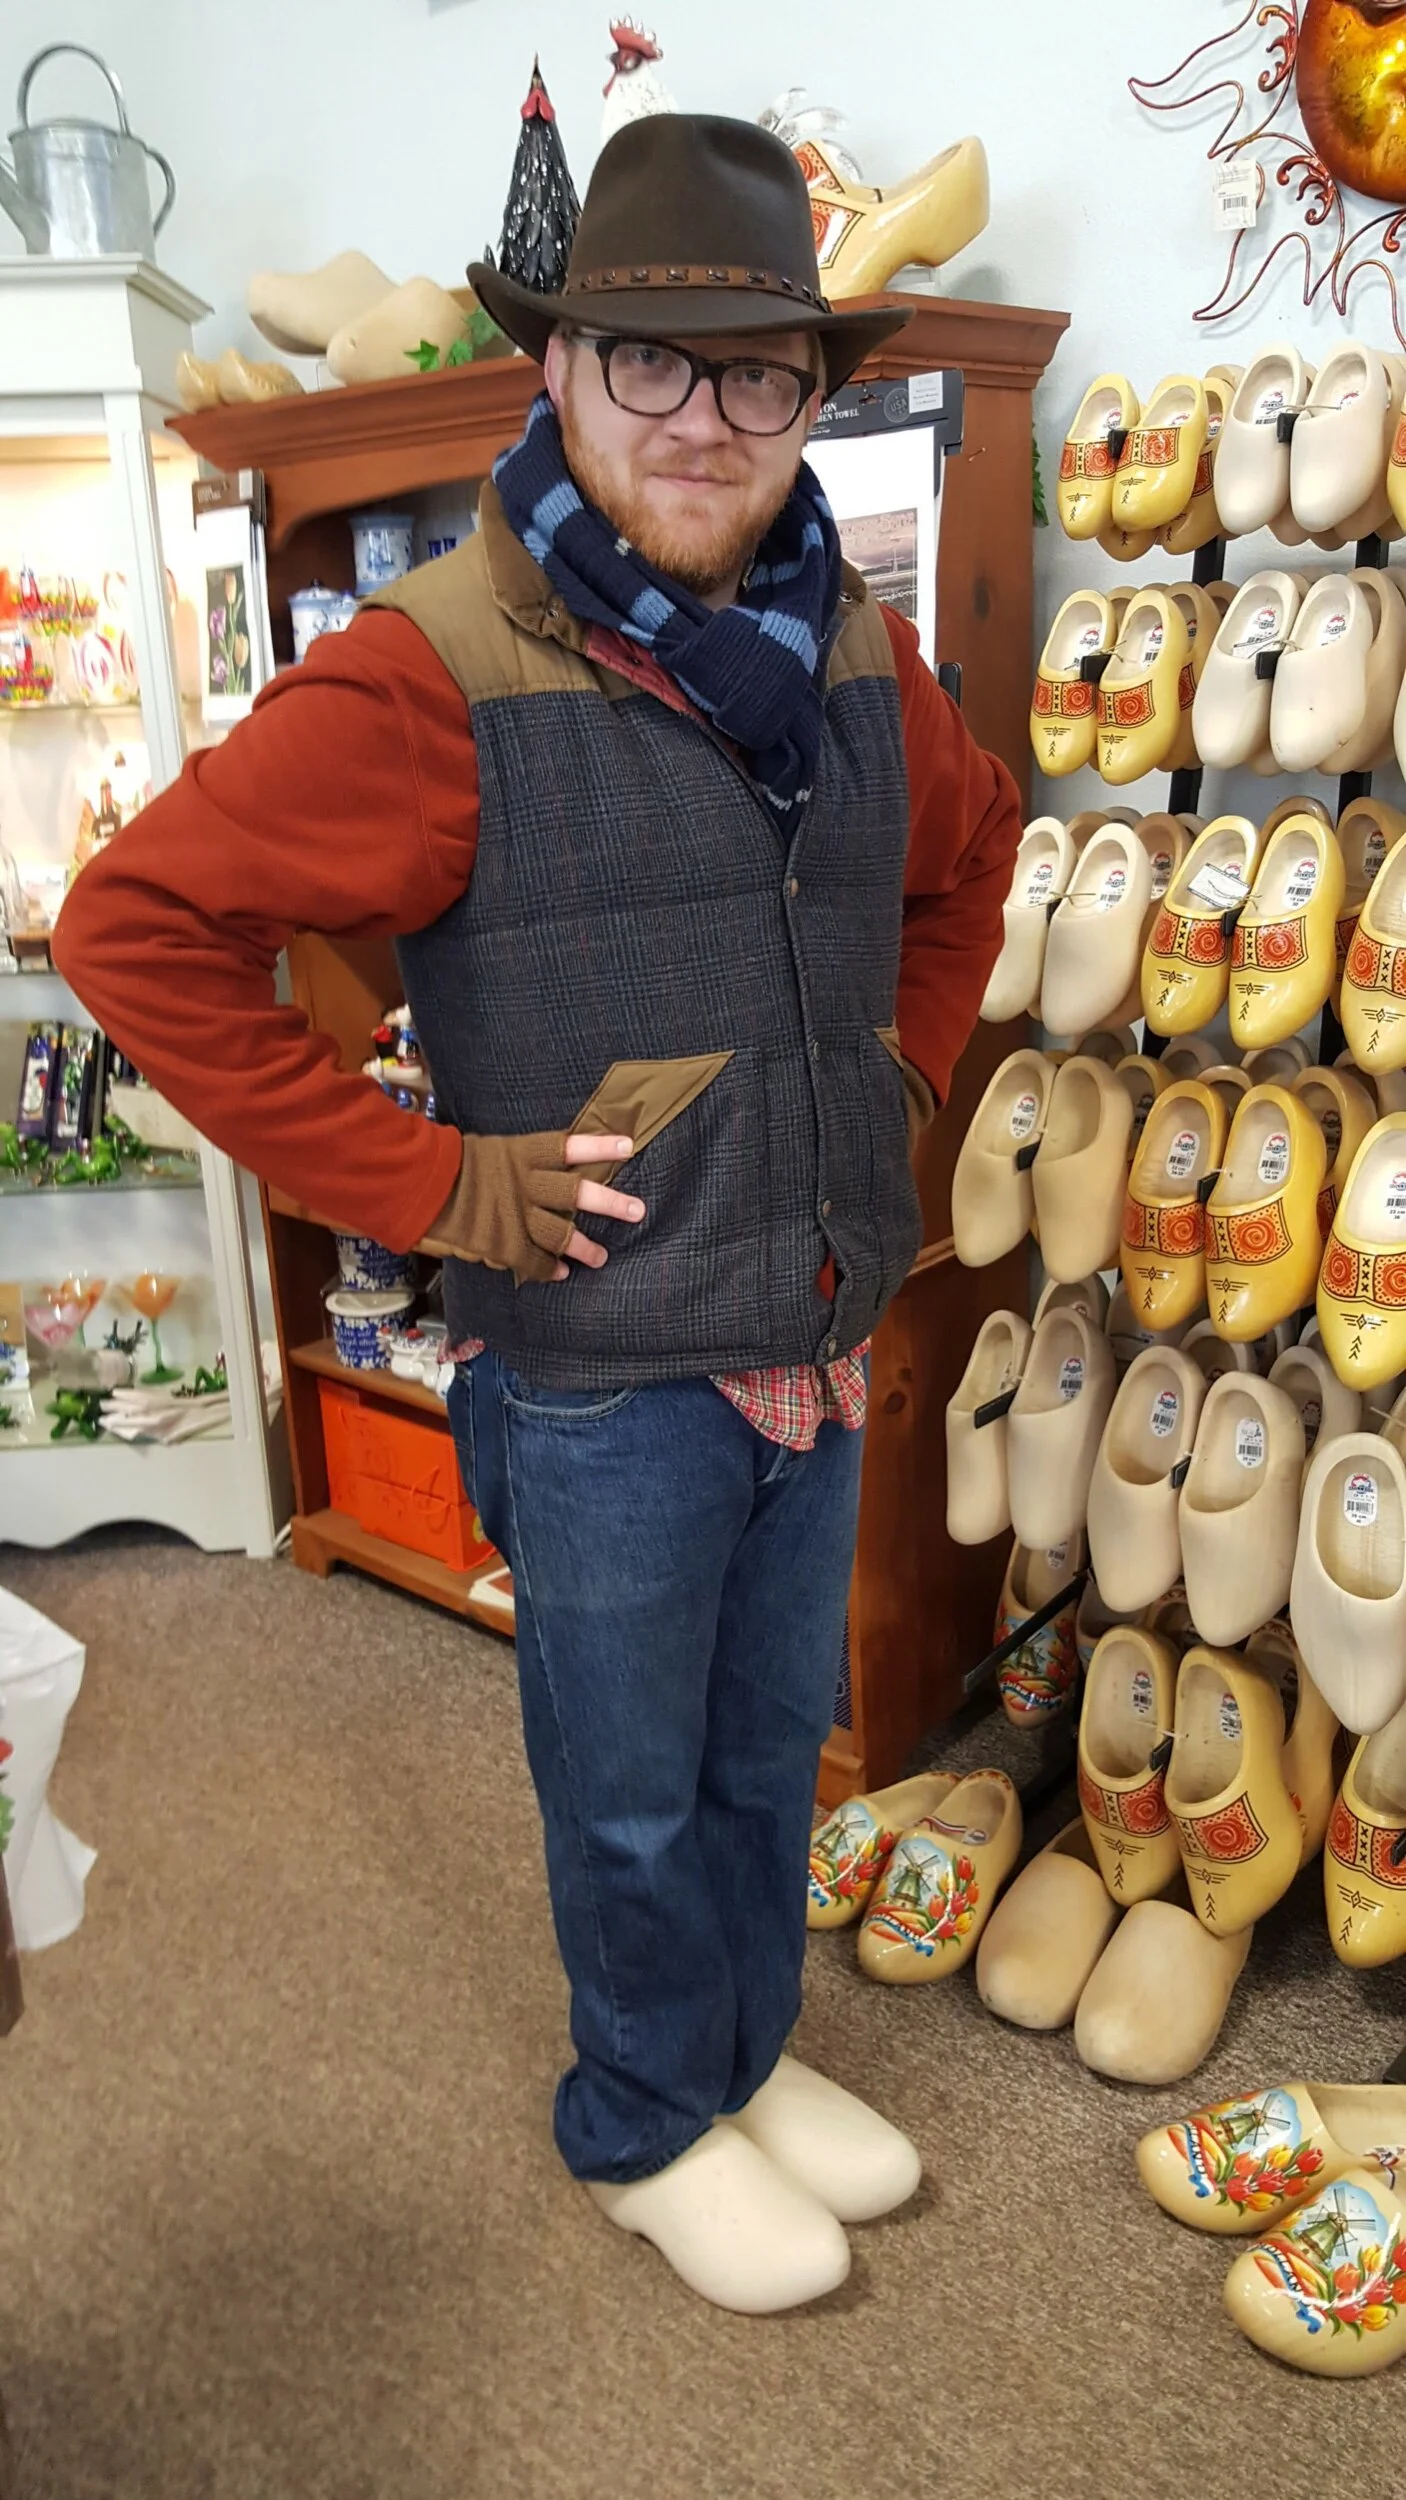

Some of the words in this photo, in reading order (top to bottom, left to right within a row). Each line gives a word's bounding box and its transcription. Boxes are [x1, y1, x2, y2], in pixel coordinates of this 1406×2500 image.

[890, 399, 907, 412] USA
[815, 410, 833, 424] HEN
[834, 408, 860, 421] TOWEL
